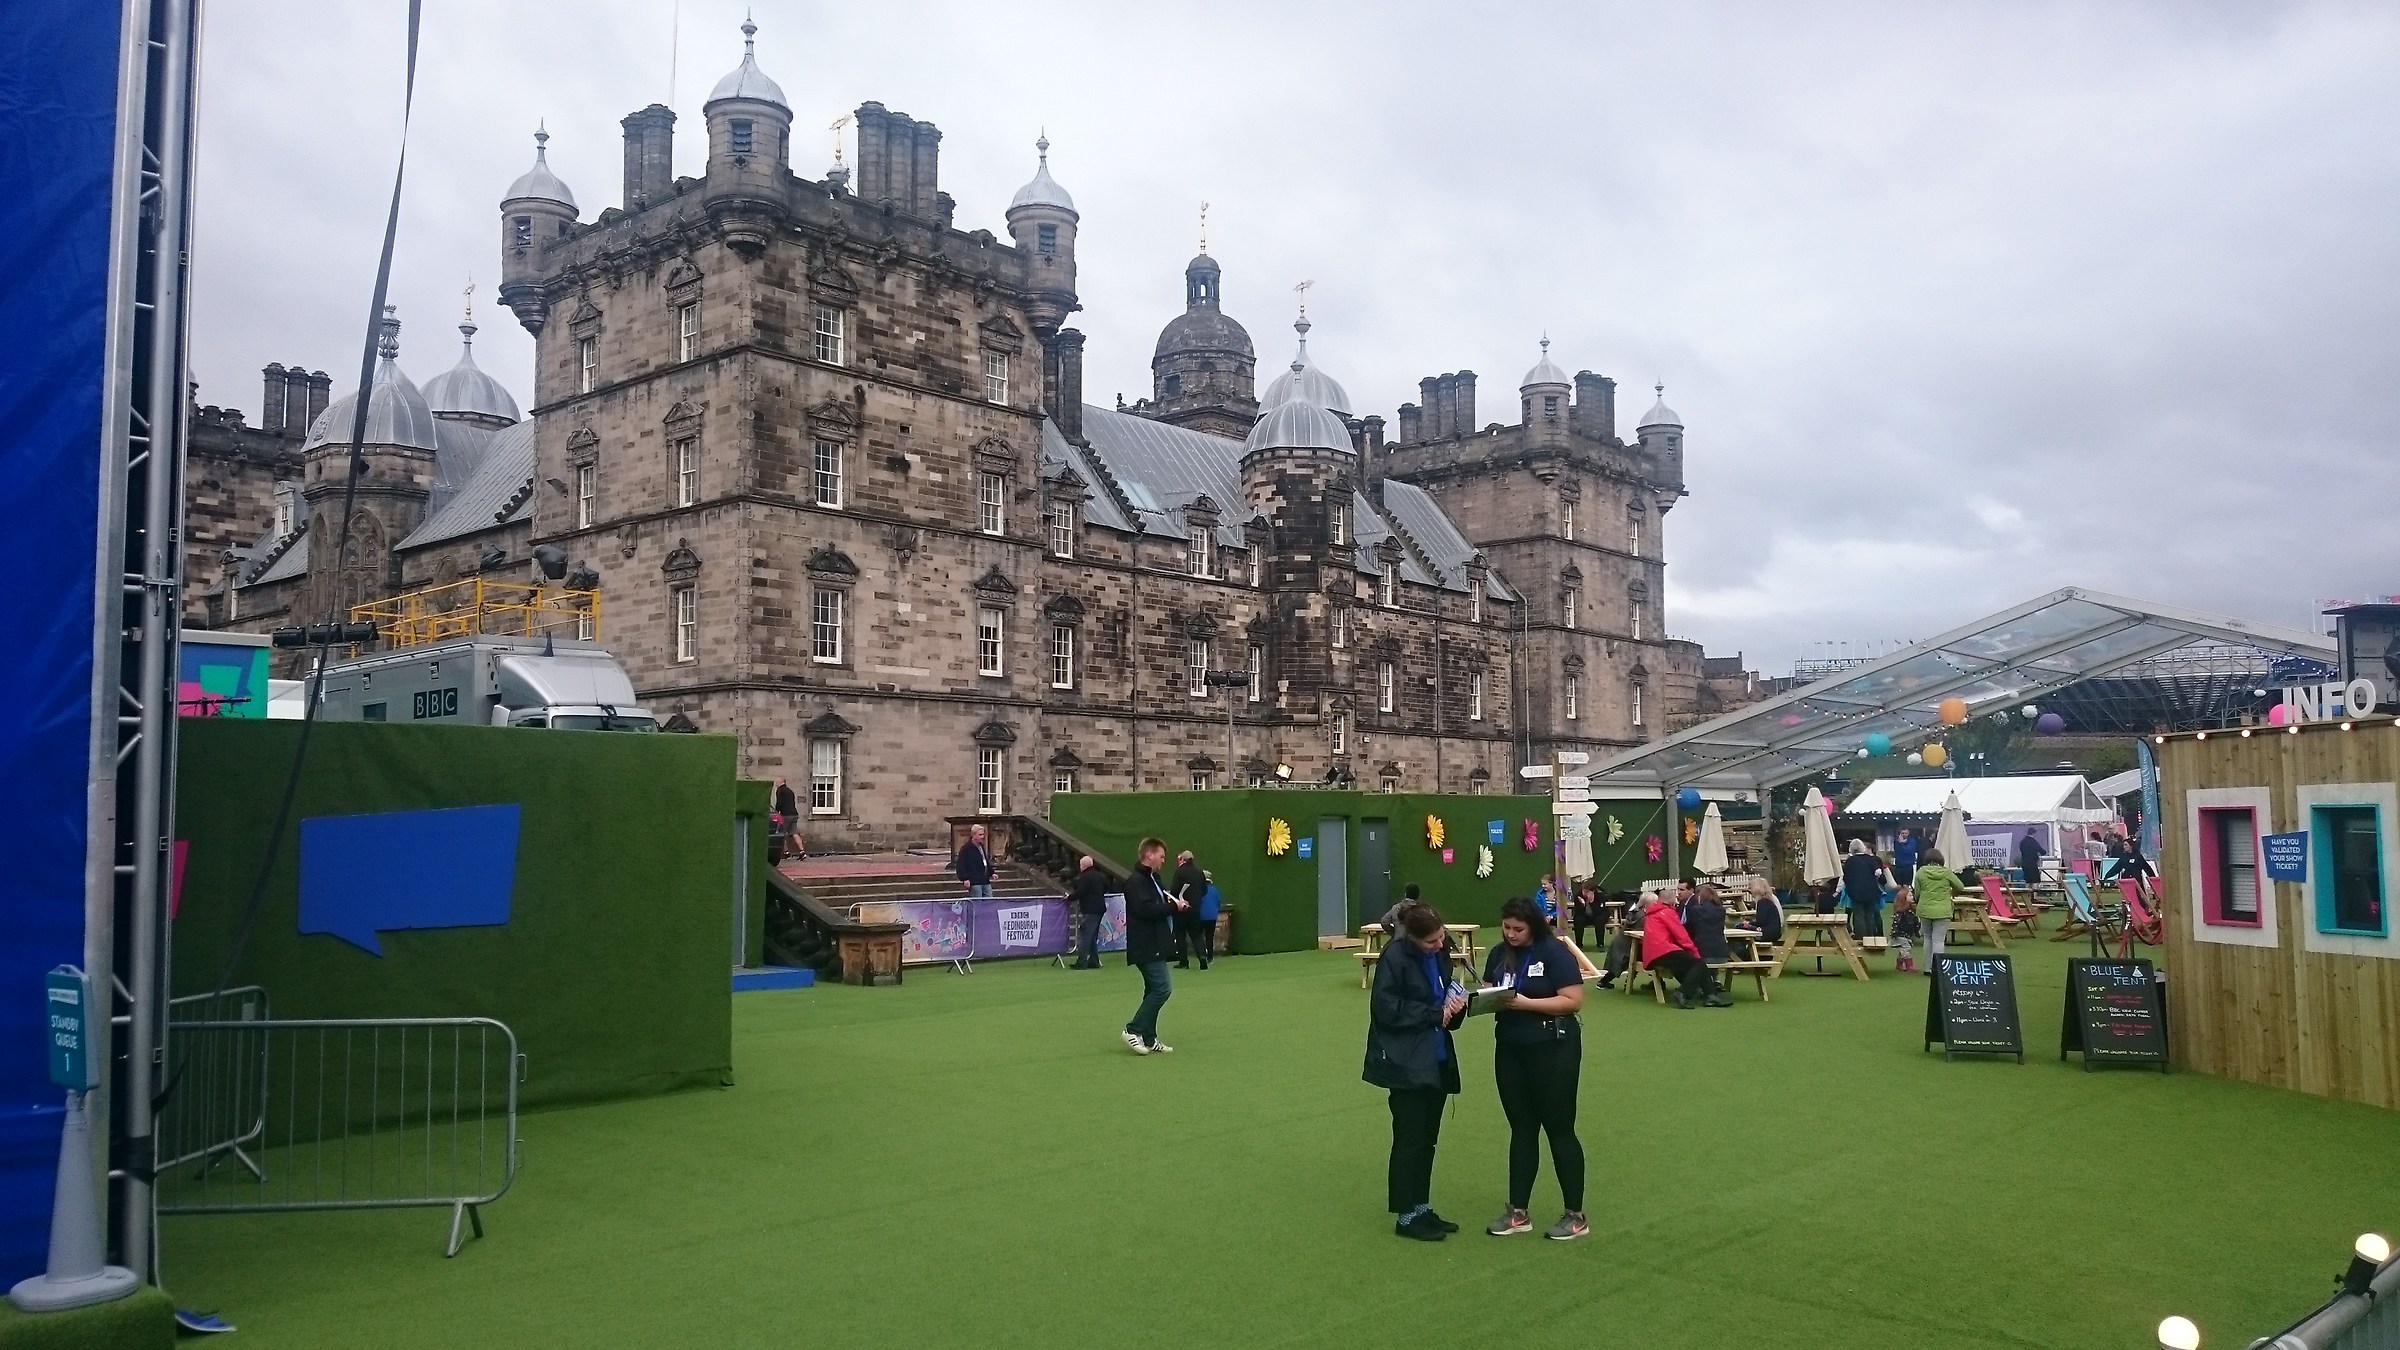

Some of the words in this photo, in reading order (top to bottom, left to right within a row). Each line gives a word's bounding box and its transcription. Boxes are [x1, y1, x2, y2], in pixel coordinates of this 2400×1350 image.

[415, 689, 457, 718] BBC
[2282, 679, 2376, 723] INFO
[1971, 848, 2007, 857] DINBURGH
[1007, 920, 1038, 930] EDINBURGH
[1955, 961, 1994, 976] BLUE
[2090, 965, 2121, 976] BLUE
[1950, 975, 1990, 985] TENT
[2113, 976, 2148, 986] TENT
[51, 1014, 79, 1031] STANDBY
[55, 1032, 77, 1049] QUEUE
